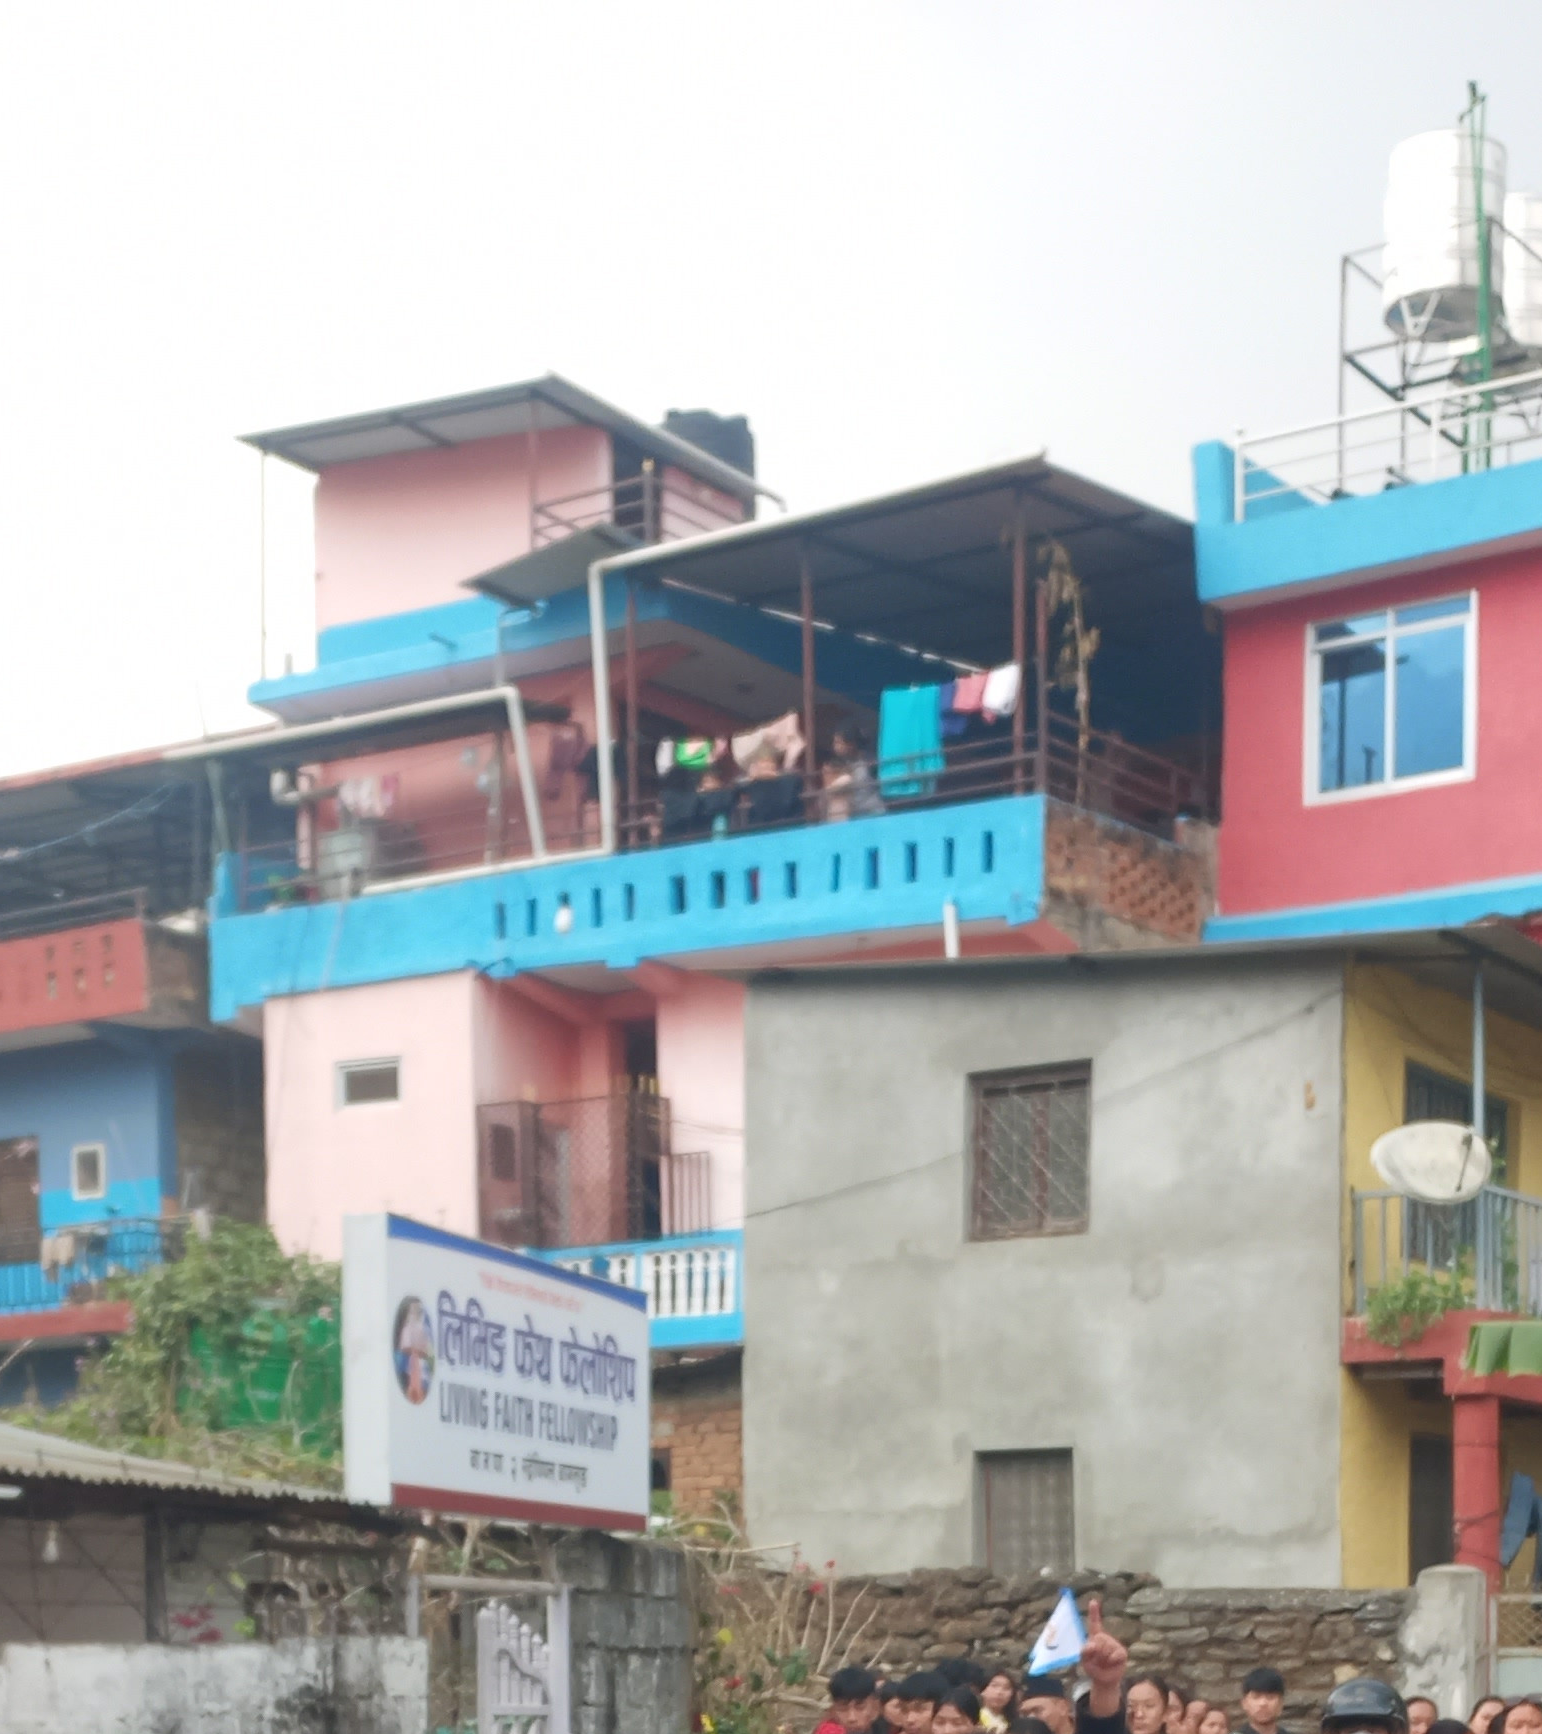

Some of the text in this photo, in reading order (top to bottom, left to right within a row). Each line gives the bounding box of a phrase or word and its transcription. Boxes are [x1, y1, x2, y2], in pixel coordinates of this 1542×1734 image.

[514, 1314, 552, 1383] फेथ
[559, 1327, 636, 1402] फेलोशिप
[440, 1382, 618, 1451] LIVING FAITH FELLOWSHIP
